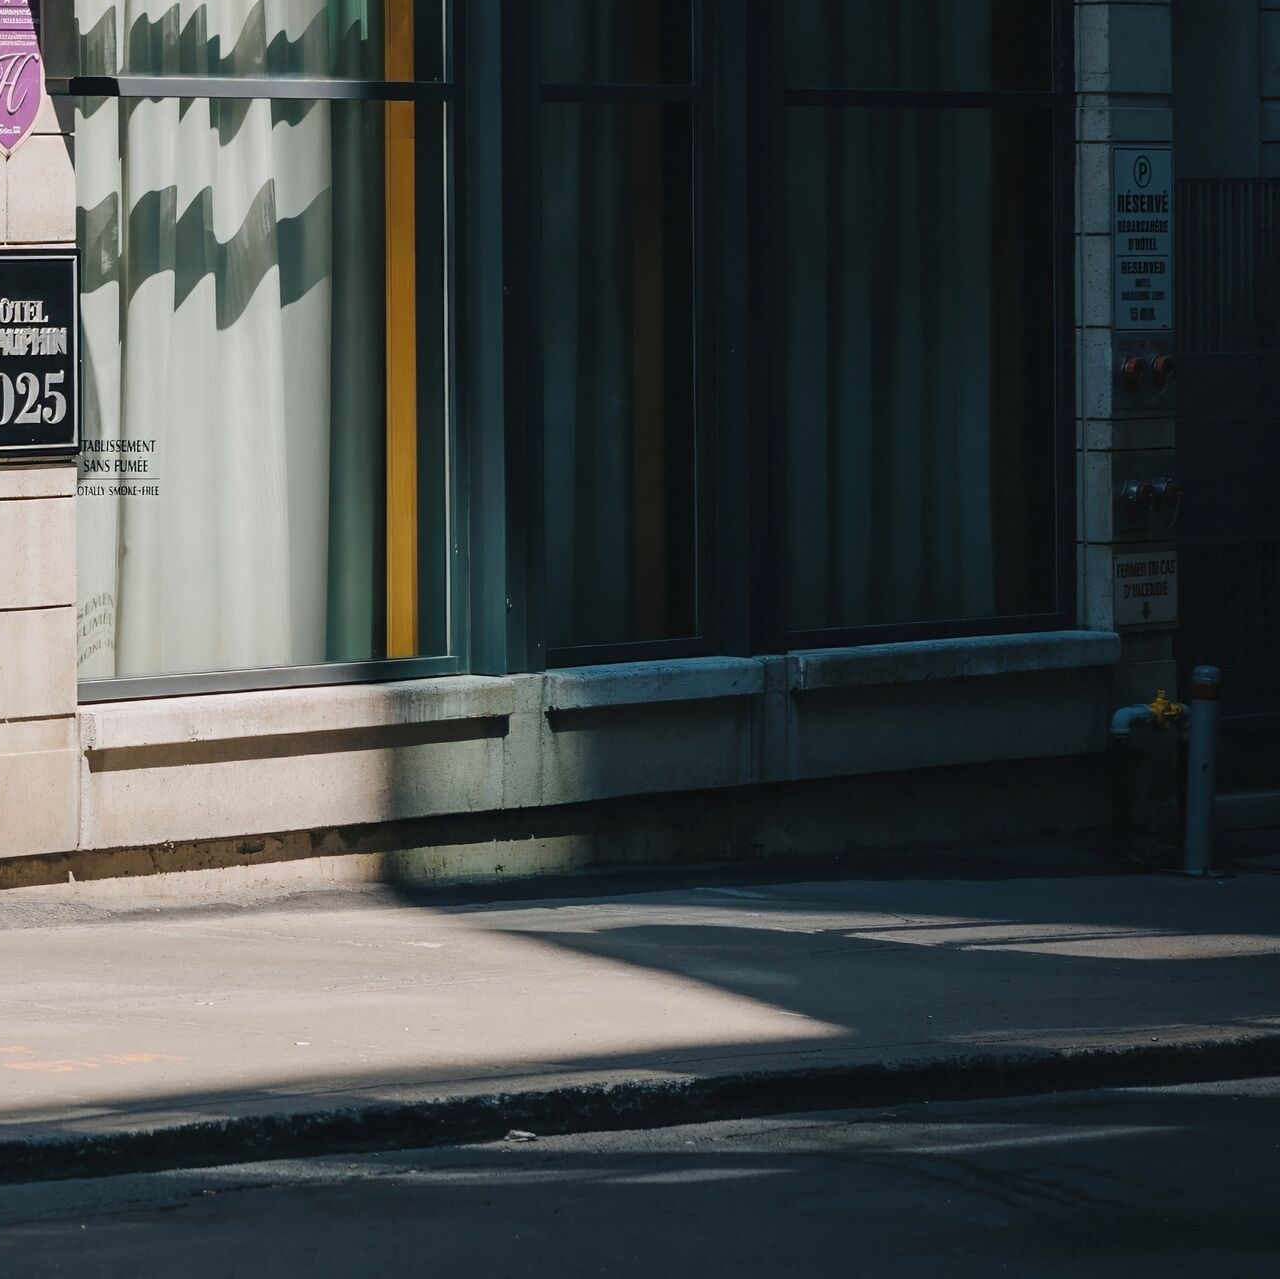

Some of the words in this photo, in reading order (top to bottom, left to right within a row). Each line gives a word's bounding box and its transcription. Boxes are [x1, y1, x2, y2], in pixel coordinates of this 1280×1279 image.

[82, 439, 157, 453] TABLISSEMENT
[83, 459, 111, 473] SANS
[114, 456, 149, 473] FUMÉE
[77, 485, 105, 496] OTALLY
